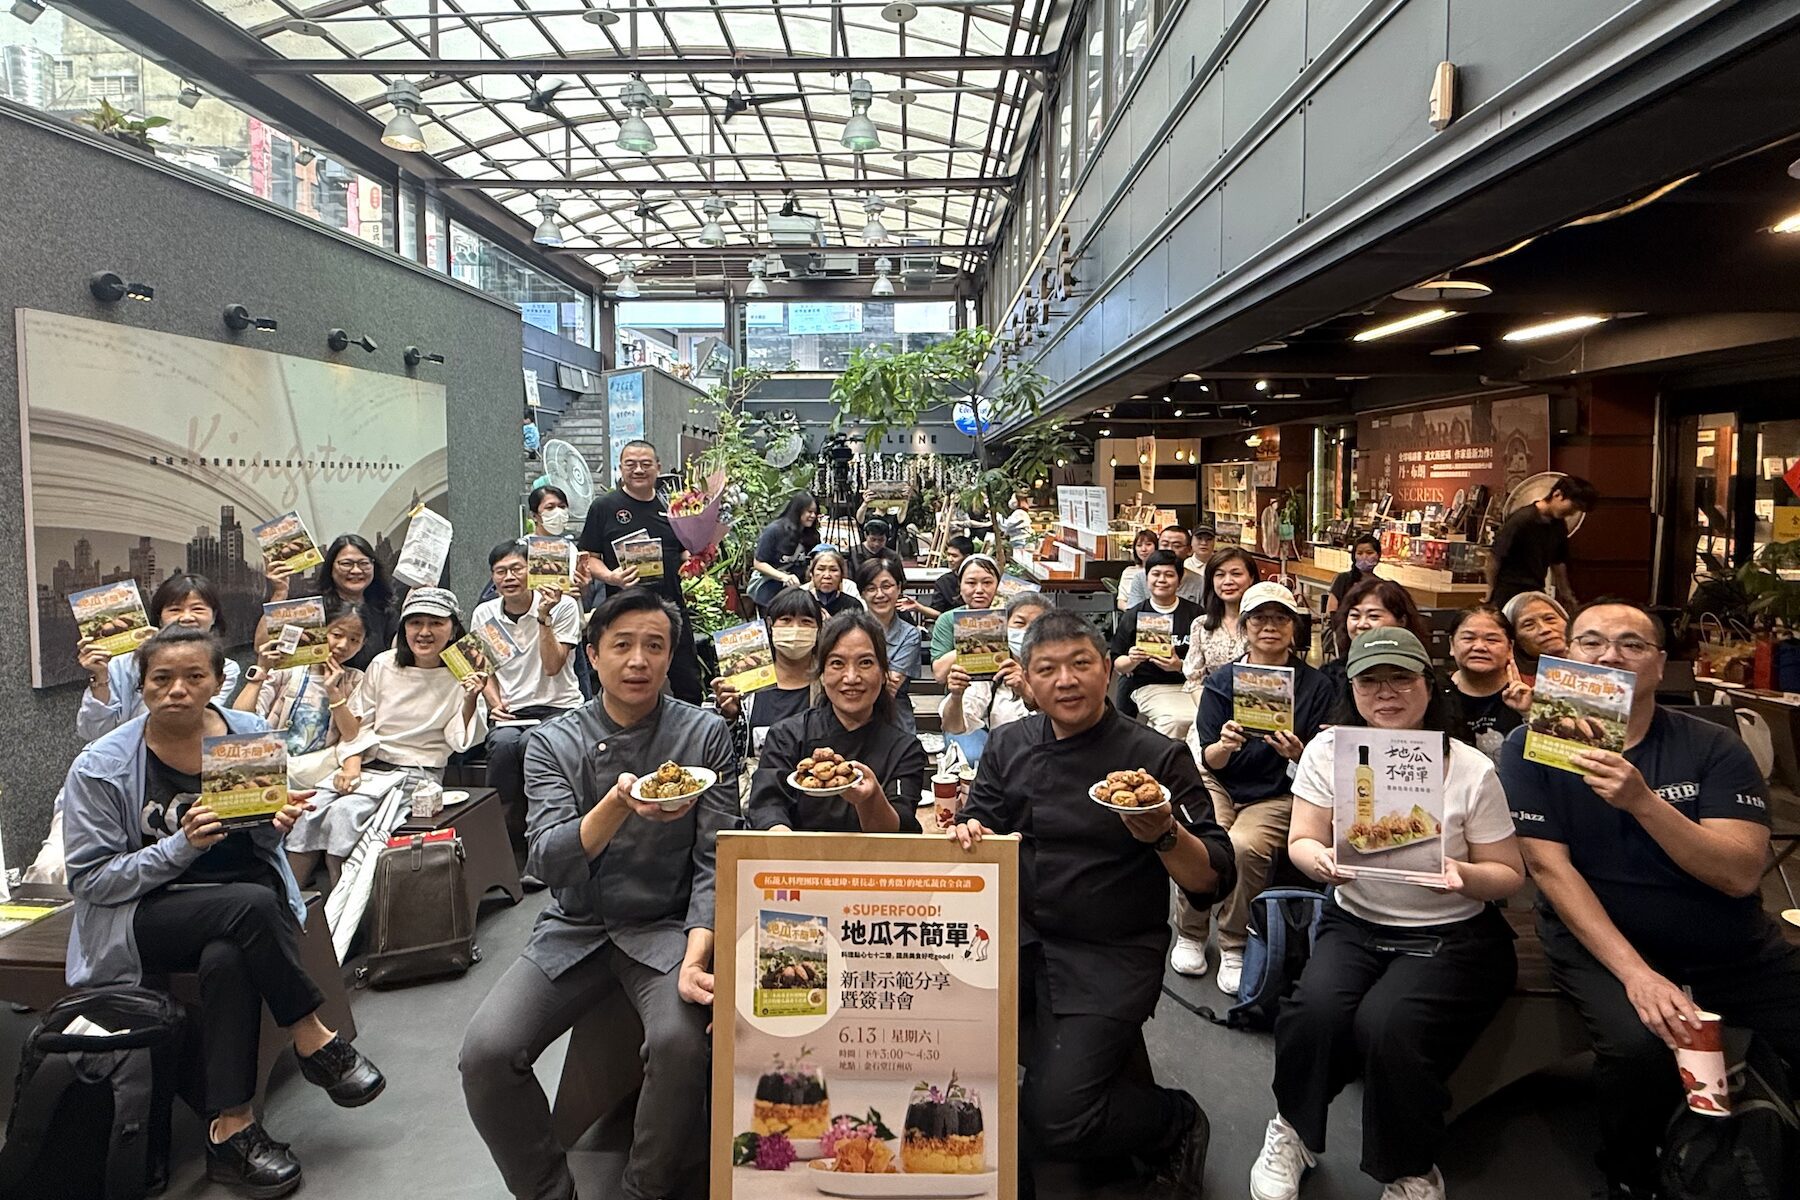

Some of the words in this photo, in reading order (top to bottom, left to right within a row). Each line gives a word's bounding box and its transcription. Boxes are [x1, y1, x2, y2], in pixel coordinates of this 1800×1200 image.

[1398, 487, 1444, 503] SECRETS
[1384, 745, 1432, 763] 地瓜
[1386, 764, 1429, 784] 不簡單
[1519, 810, 1545, 822] Jazz
[852, 904, 942, 917] SUPERFOOD!
[841, 920, 970, 948] 地瓜不簡單
[840, 970, 951, 991] 新書示範分享
[840, 990, 914, 1010] 暨簽書會
[838, 1026, 877, 1044] 6.13
[892, 1029, 932, 1044] 星期六
